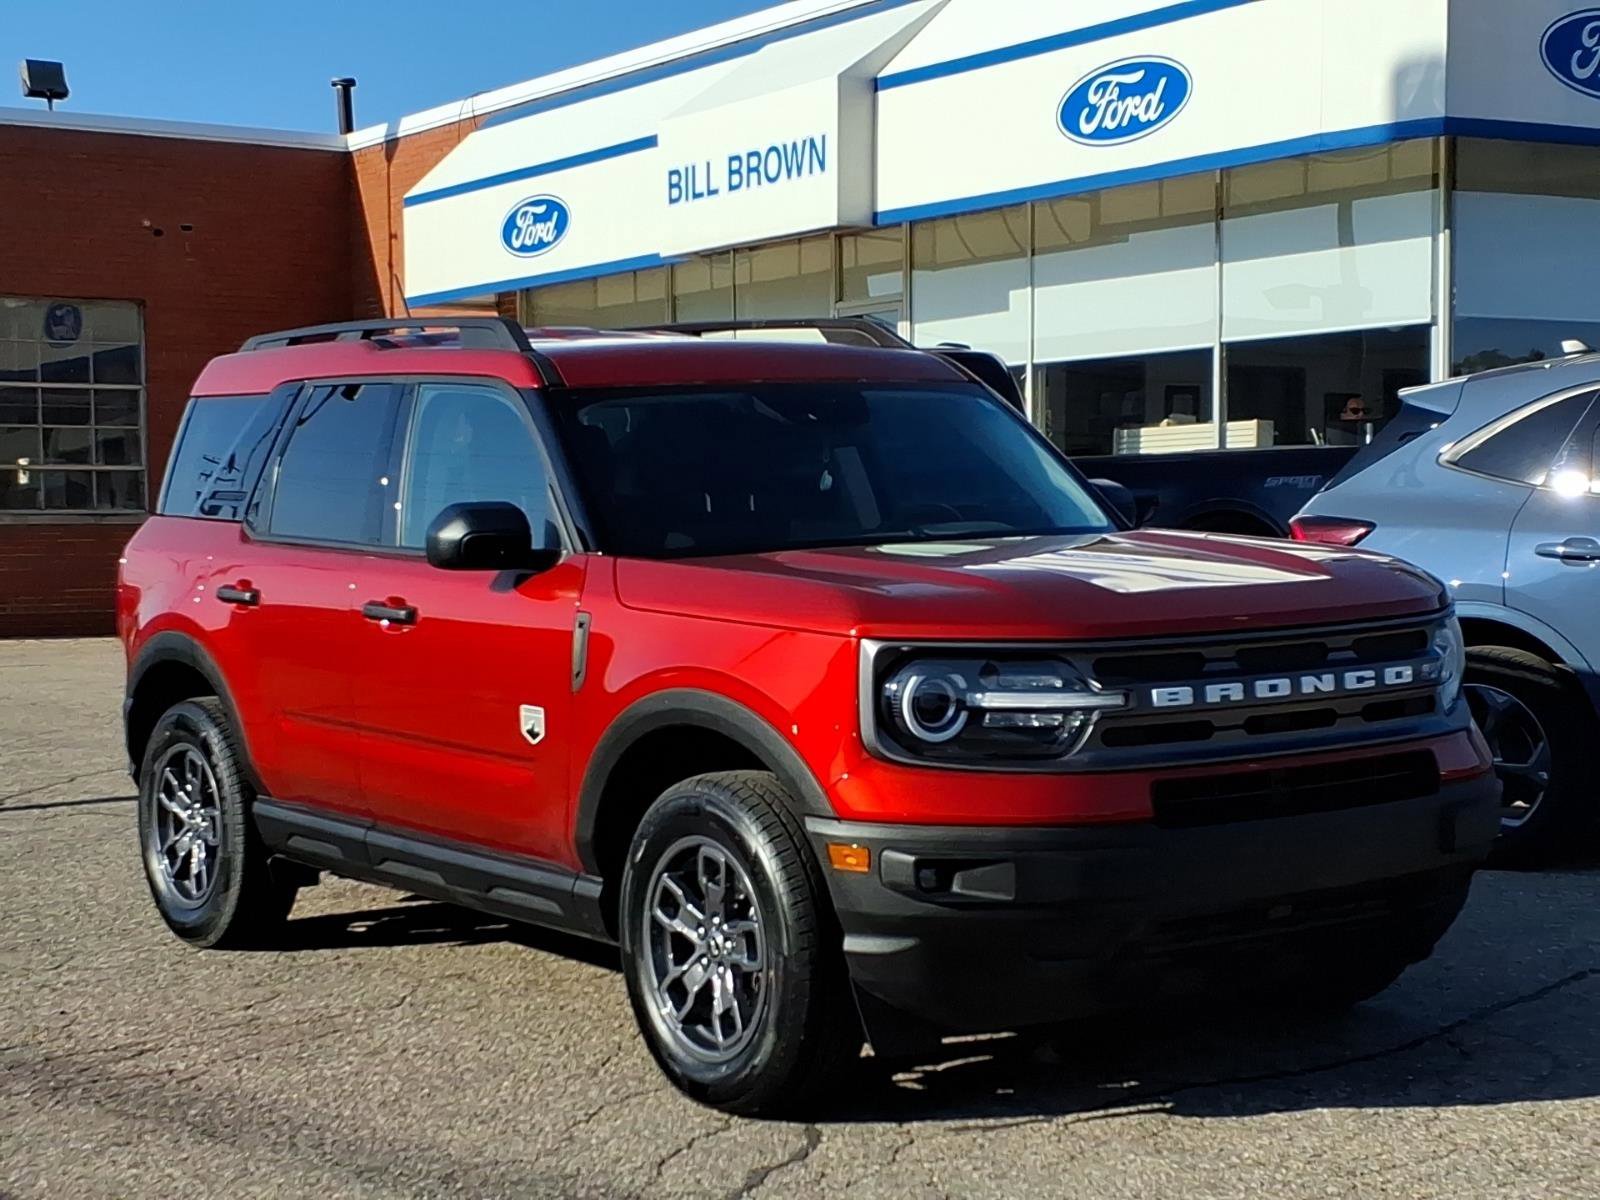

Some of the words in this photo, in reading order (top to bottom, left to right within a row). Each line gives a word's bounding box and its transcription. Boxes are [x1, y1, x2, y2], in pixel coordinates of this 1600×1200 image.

[1079, 69, 1167, 135] Ford
[668, 161, 719, 205] BILL
[728, 134, 826, 192] BROWN
[511, 203, 558, 249] Ford
[1151, 665, 1413, 707] BRONCO
